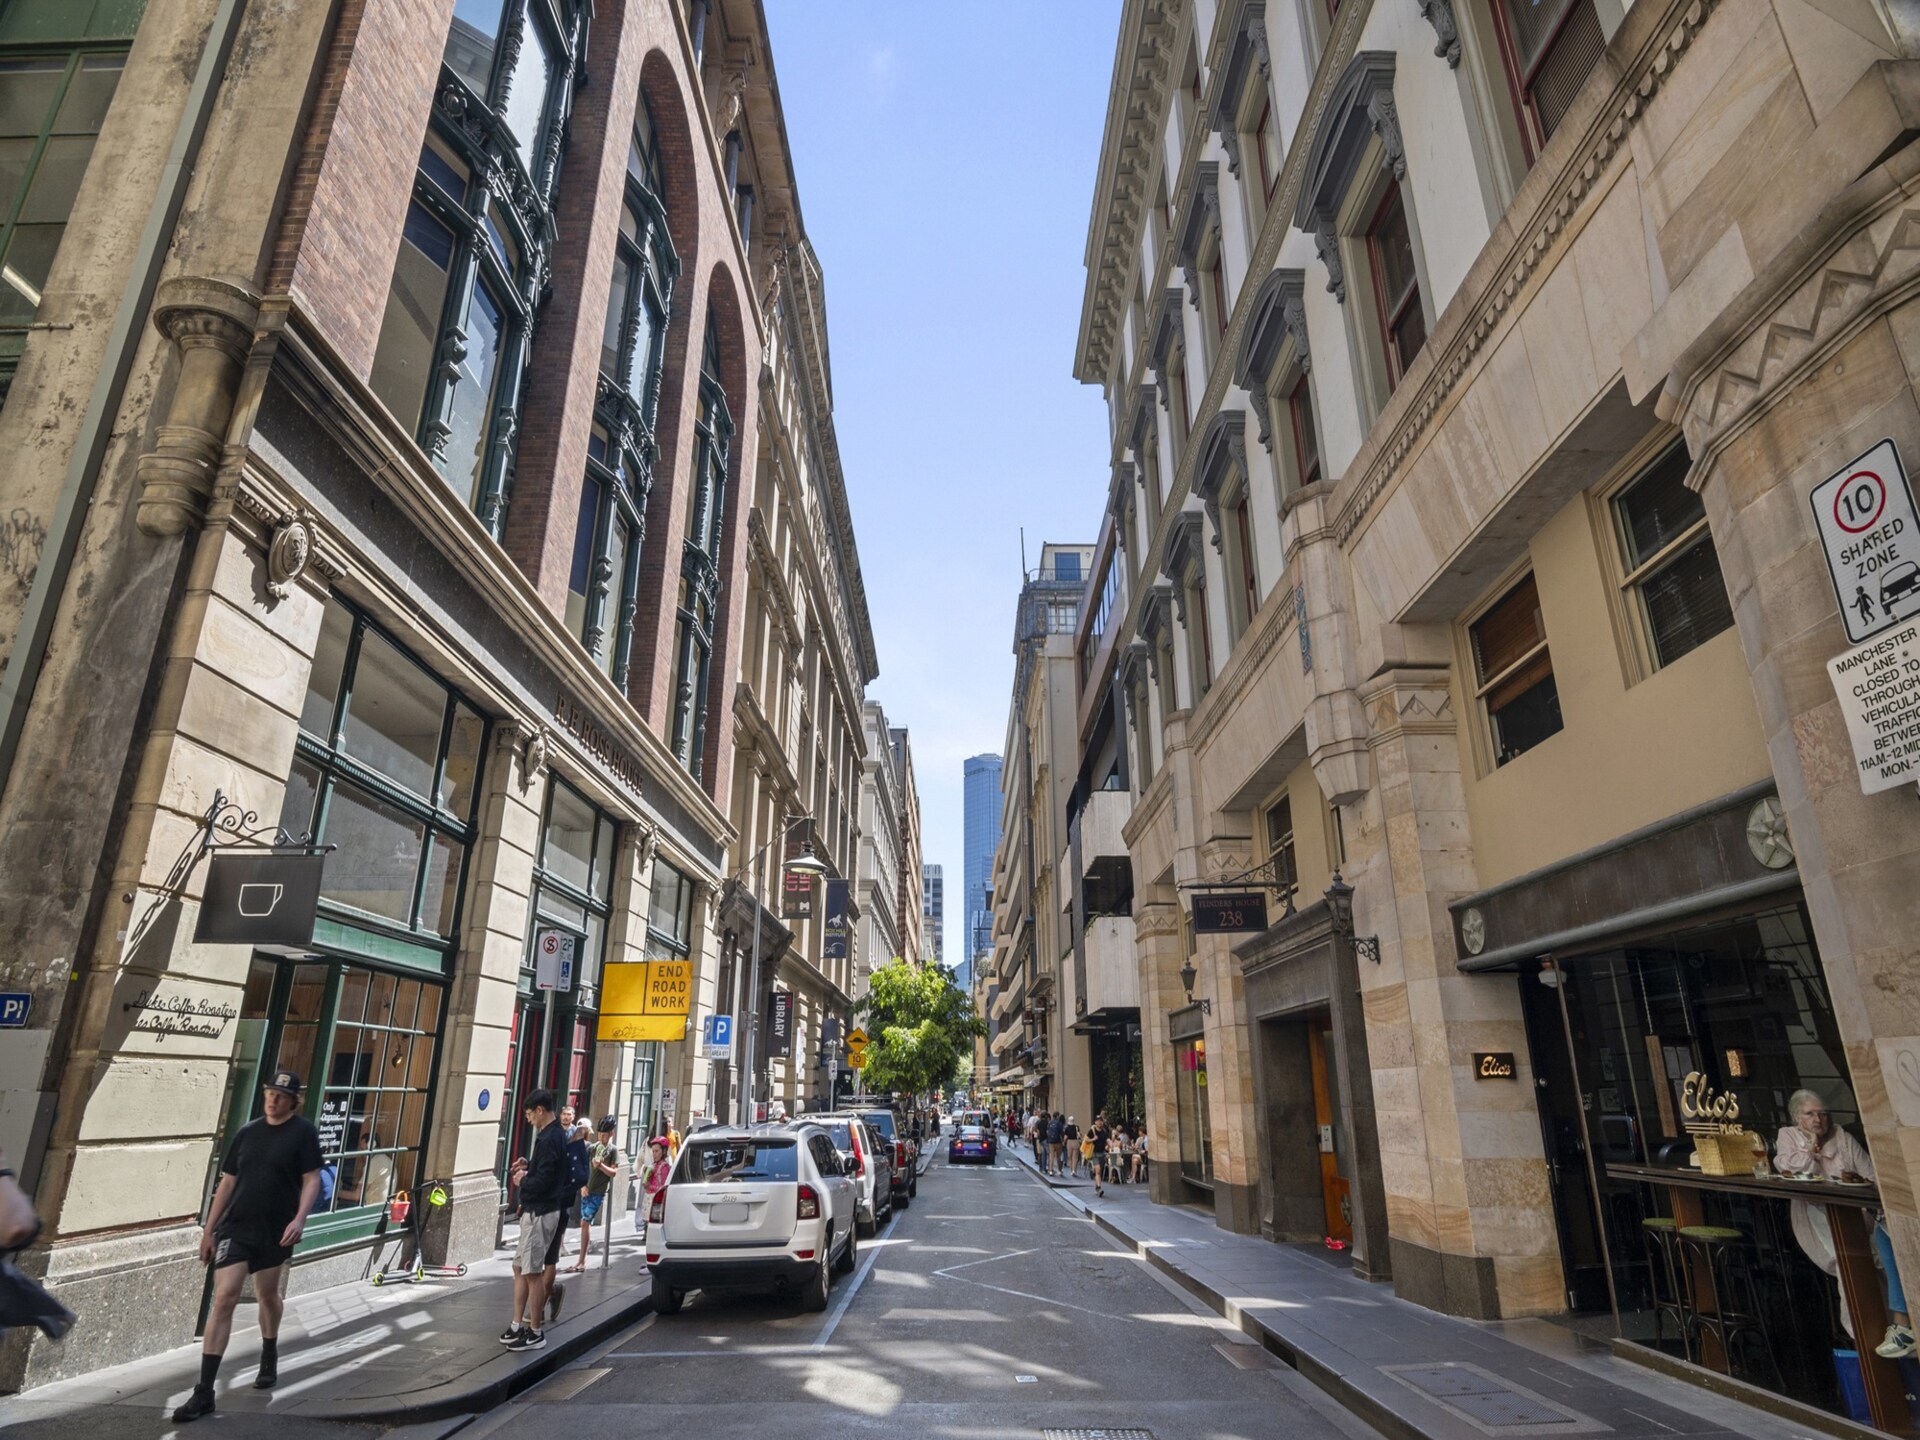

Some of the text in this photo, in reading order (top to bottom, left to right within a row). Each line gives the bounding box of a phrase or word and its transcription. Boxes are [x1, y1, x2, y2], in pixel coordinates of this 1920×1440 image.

[1843, 484, 1875, 522] 10
[1840, 518, 1904, 566] SHARED
[1856, 543, 1900, 580] ZONE
[1836, 627, 1918, 675] MANCHESTER
[1853, 657, 1920, 697] CLOSED TO
[1864, 653, 1898, 677] LANE
[581, 718, 610, 764] ROSS
[611, 748, 644, 796] HOUSE
[1198, 898, 1261, 909] FLINDERS HOUSE
[1219, 911, 1244, 927] 238
[658, 965, 683, 977] END
[652, 980, 686, 993] ROAD
[651, 996, 685, 1008] WORK
[774, 995, 786, 1037] LIBRARY
[716, 1021, 727, 1041] P
[323, 1101, 336, 1113] Only
[1681, 1071, 1740, 1119] Elio's
[1719, 1123, 1744, 1136] PLACE
